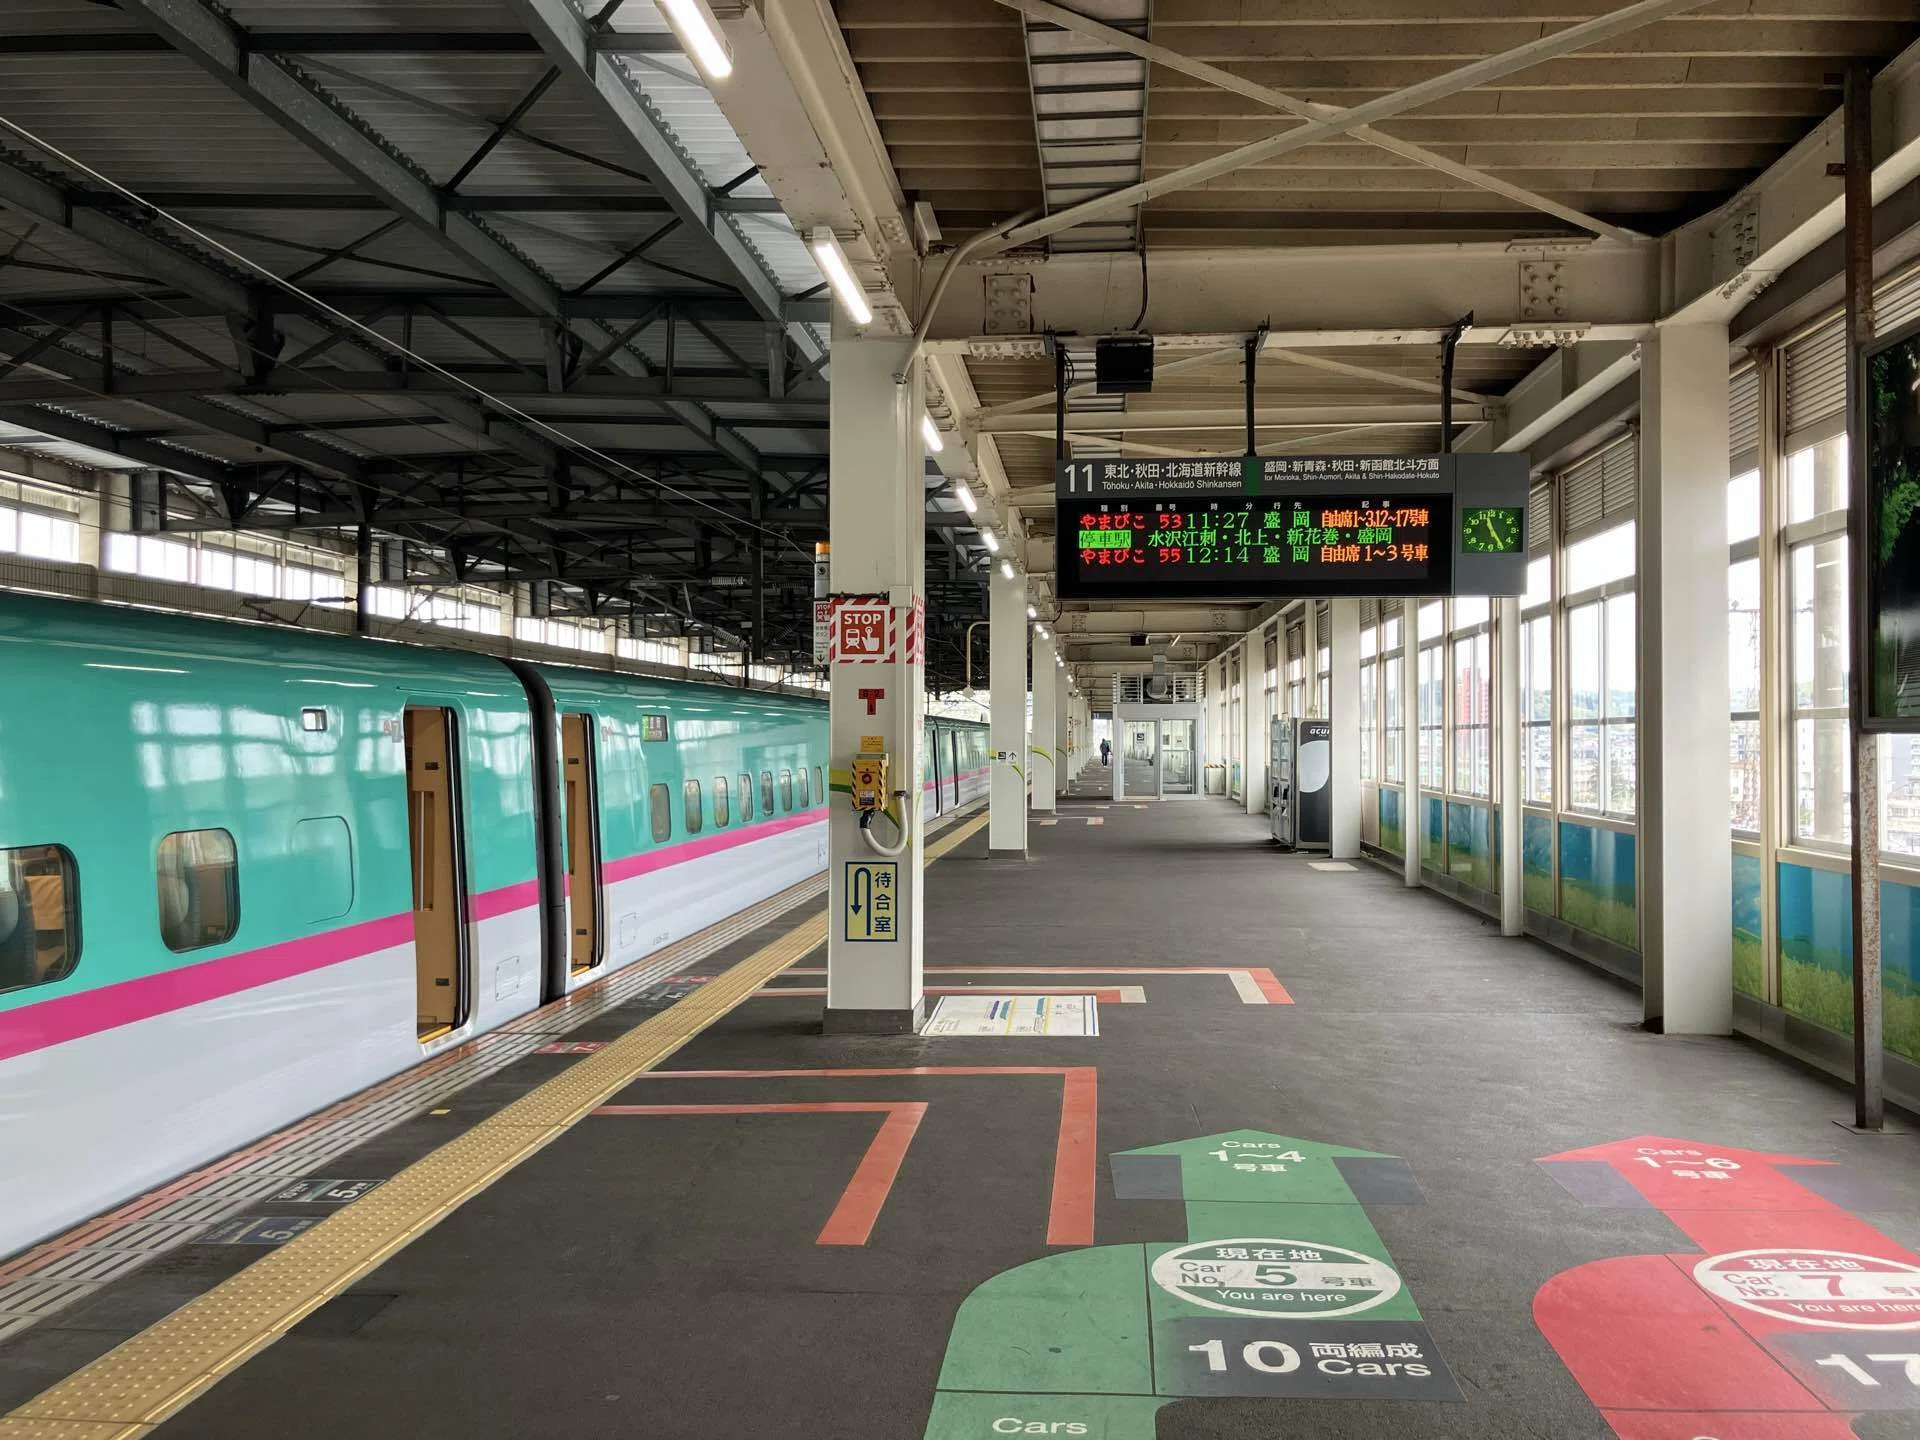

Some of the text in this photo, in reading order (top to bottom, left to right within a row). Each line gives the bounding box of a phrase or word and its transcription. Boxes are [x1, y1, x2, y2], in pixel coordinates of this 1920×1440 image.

[1104, 461, 1242, 479] 東北・秋田・北海道新幹線
[1064, 463, 1093, 493] 11
[1196, 479, 1242, 489] Shinkansen
[1080, 513, 1145, 529] やまびこ
[1160, 514, 1182, 529] 53
[1187, 512, 1249, 529] 11:27
[1080, 548, 1145, 564] やまびこ
[1160, 548, 1181, 563] 55
[1187, 547, 1249, 563] 12:14
[844, 613, 882, 625] STOP
[874, 871, 892, 933] 待合室
[1220, 1141, 1281, 1149] Cars
[1636, 1147, 1703, 1156] Cars
[1232, 1163, 1288, 1173] 号車
[327, 1189, 359, 1199] 5
[1215, 1247, 1323, 1262] 現在地
[1179, 1262, 1226, 1274] Car
[1744, 1258, 1866, 1270] 現在地
[1254, 1265, 1298, 1286] 5
[1320, 1276, 1376, 1287] 号車
[1722, 1273, 1773, 1285] Car
[1799, 1275, 1846, 1297] 7
[1215, 1289, 1347, 1303] You are here
[1788, 1302, 1836, 1313] You
[1838, 1304, 1876, 1313] are
[1188, 1339, 1301, 1373] 10
[1308, 1342, 1424, 1359] 両編成
[1316, 1360, 1432, 1377] Cars
[992, 1417, 1088, 1435] Cars
